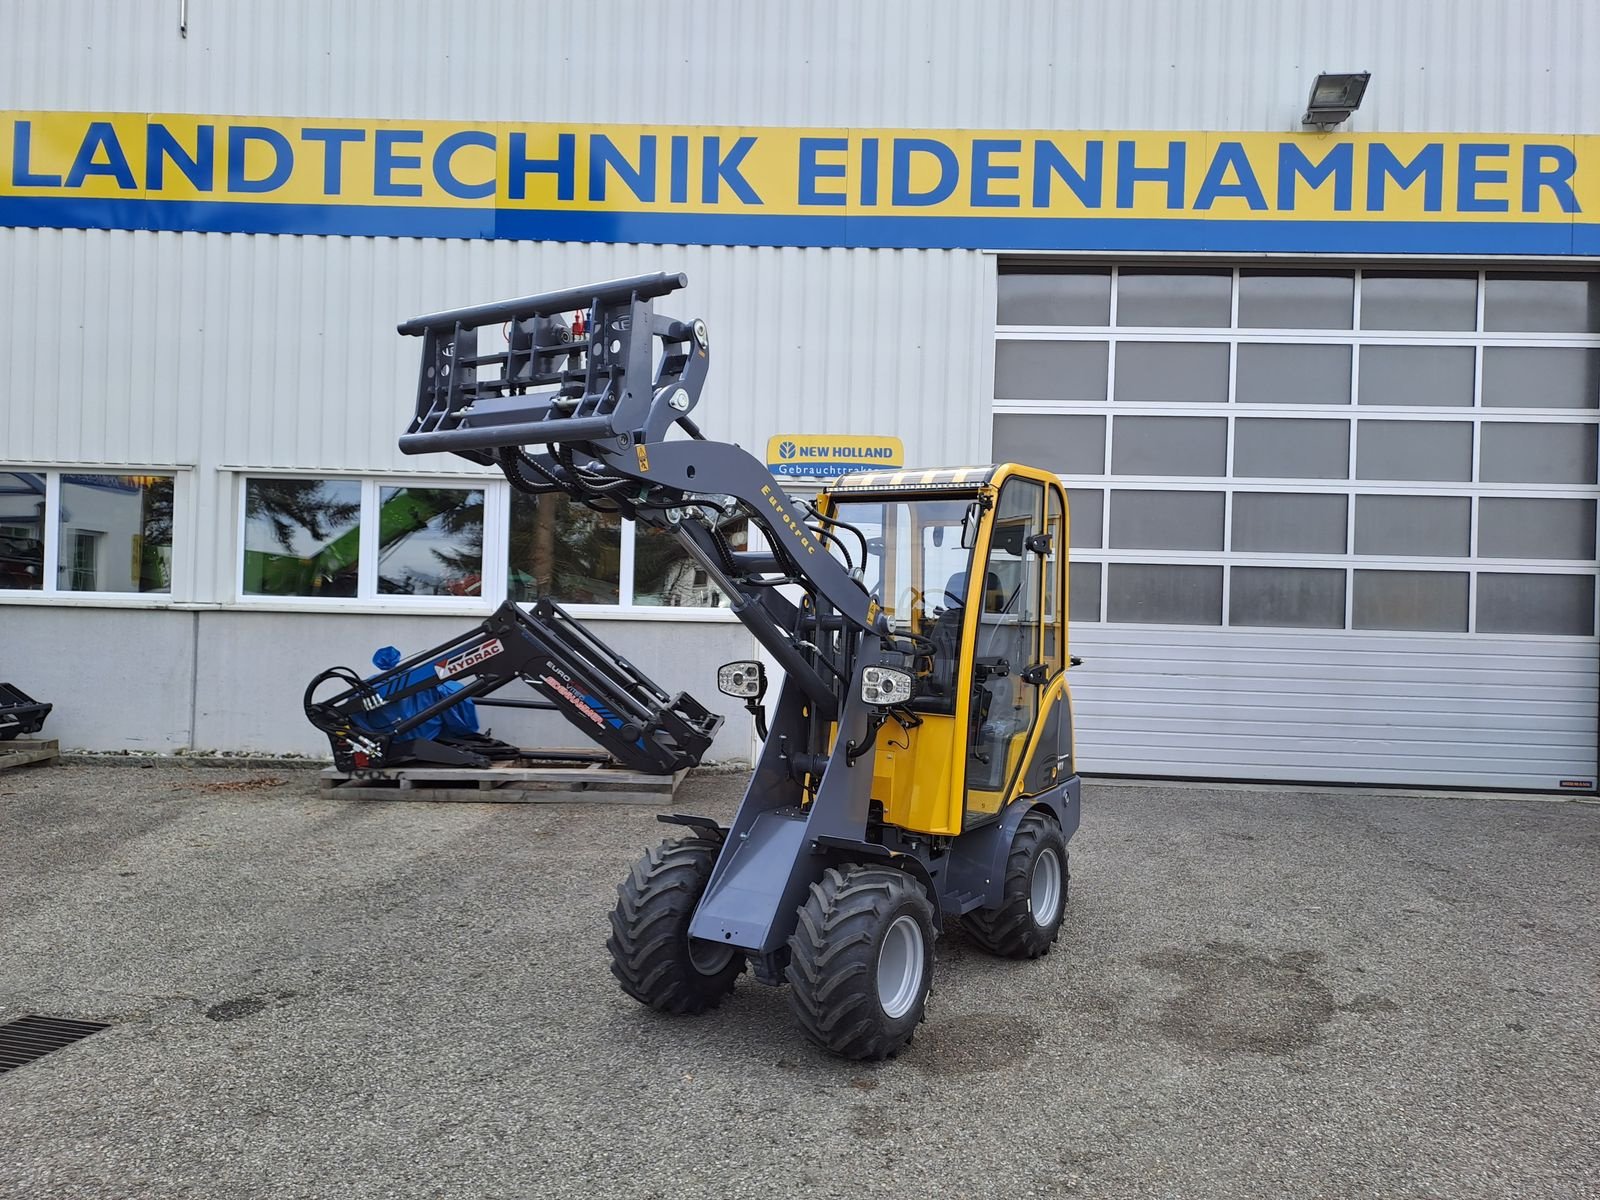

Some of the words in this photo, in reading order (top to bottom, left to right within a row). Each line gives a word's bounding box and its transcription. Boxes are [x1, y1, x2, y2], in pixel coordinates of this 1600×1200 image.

[12, 120, 765, 206] LANDTECHNIK
[798, 137, 1582, 214] EIDENHAMMER
[799, 446, 829, 457] NEW
[832, 447, 893, 459] HOLLAND
[760, 484, 815, 555] Eurotrac
[447, 645, 500, 674] HYDRAC
[546, 660, 571, 682] EURO
